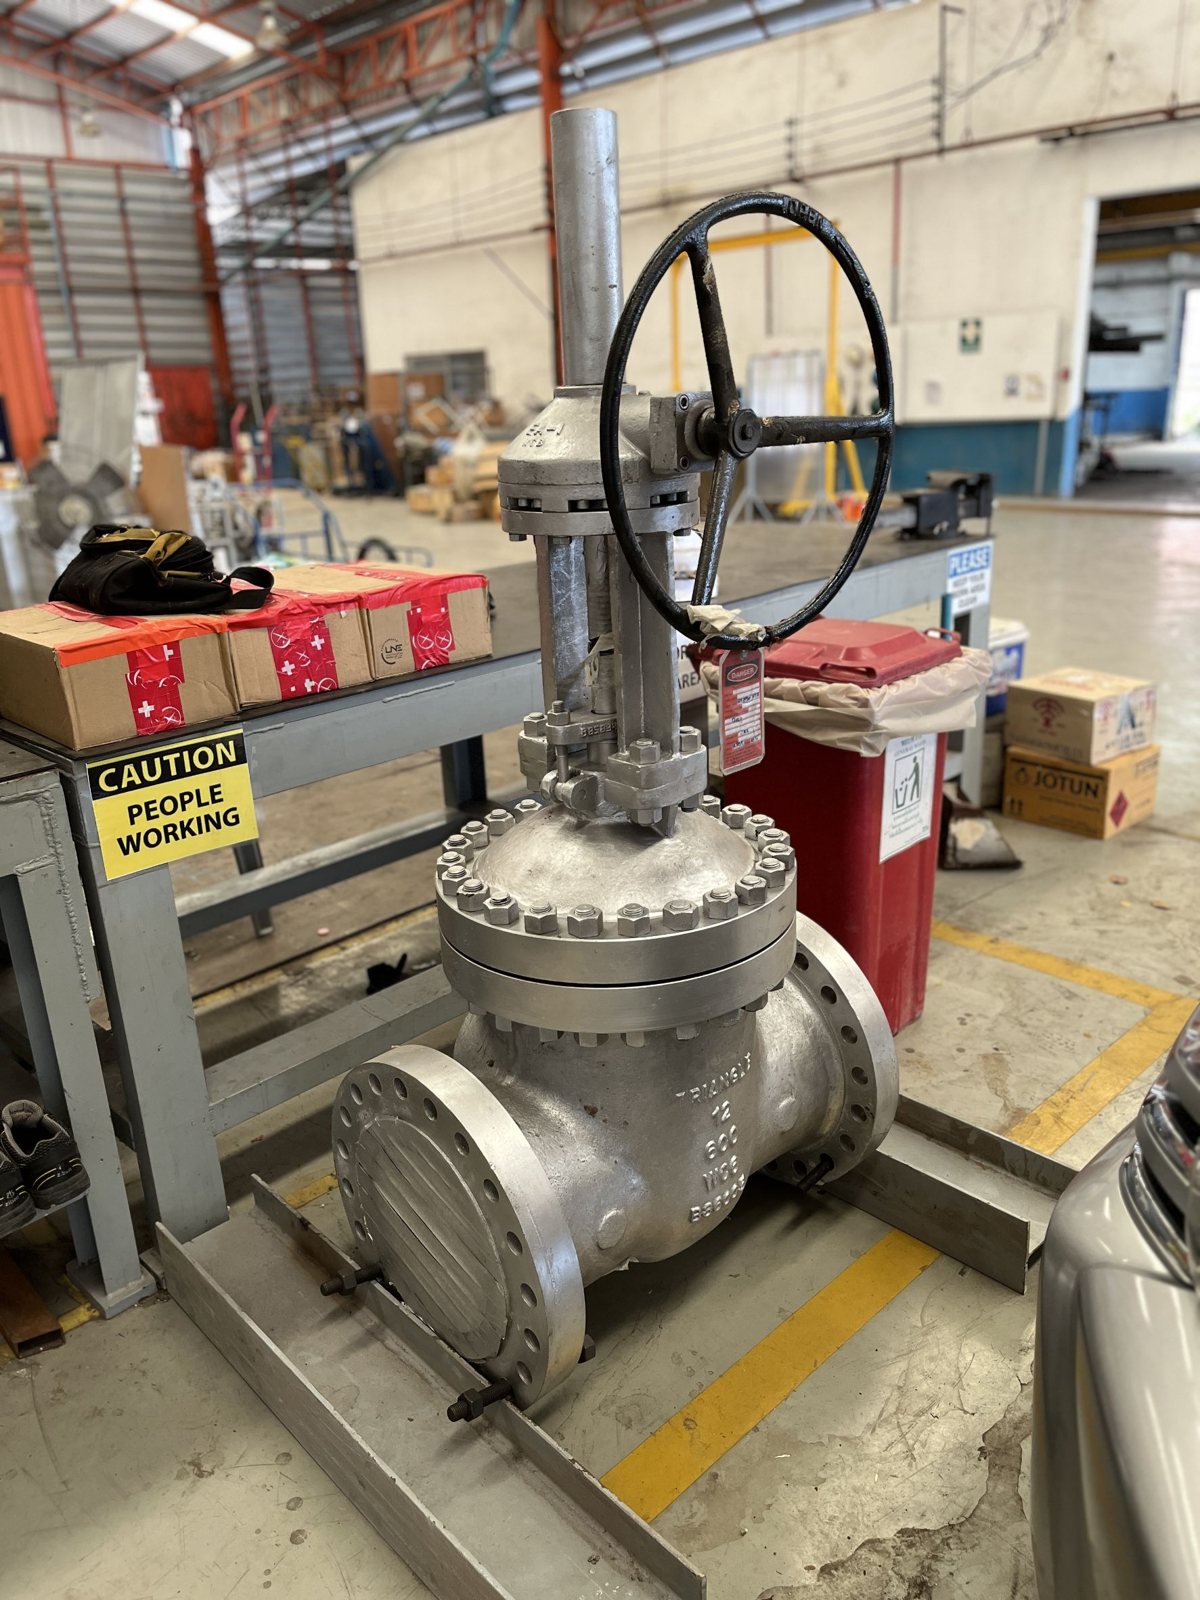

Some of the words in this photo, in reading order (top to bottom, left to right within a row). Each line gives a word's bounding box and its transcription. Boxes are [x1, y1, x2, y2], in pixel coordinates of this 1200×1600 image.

[949, 546, 989, 576] PLEASE
[731, 667, 756, 680] DANGER
[98, 740, 237, 792] CAUTION
[1035, 770, 1100, 798] JOTUN
[127, 783, 224, 826] PEOPLE
[116, 807, 241, 856] WORKING
[711, 1100, 731, 1127] 12
[704, 1124, 738, 1160] 600
